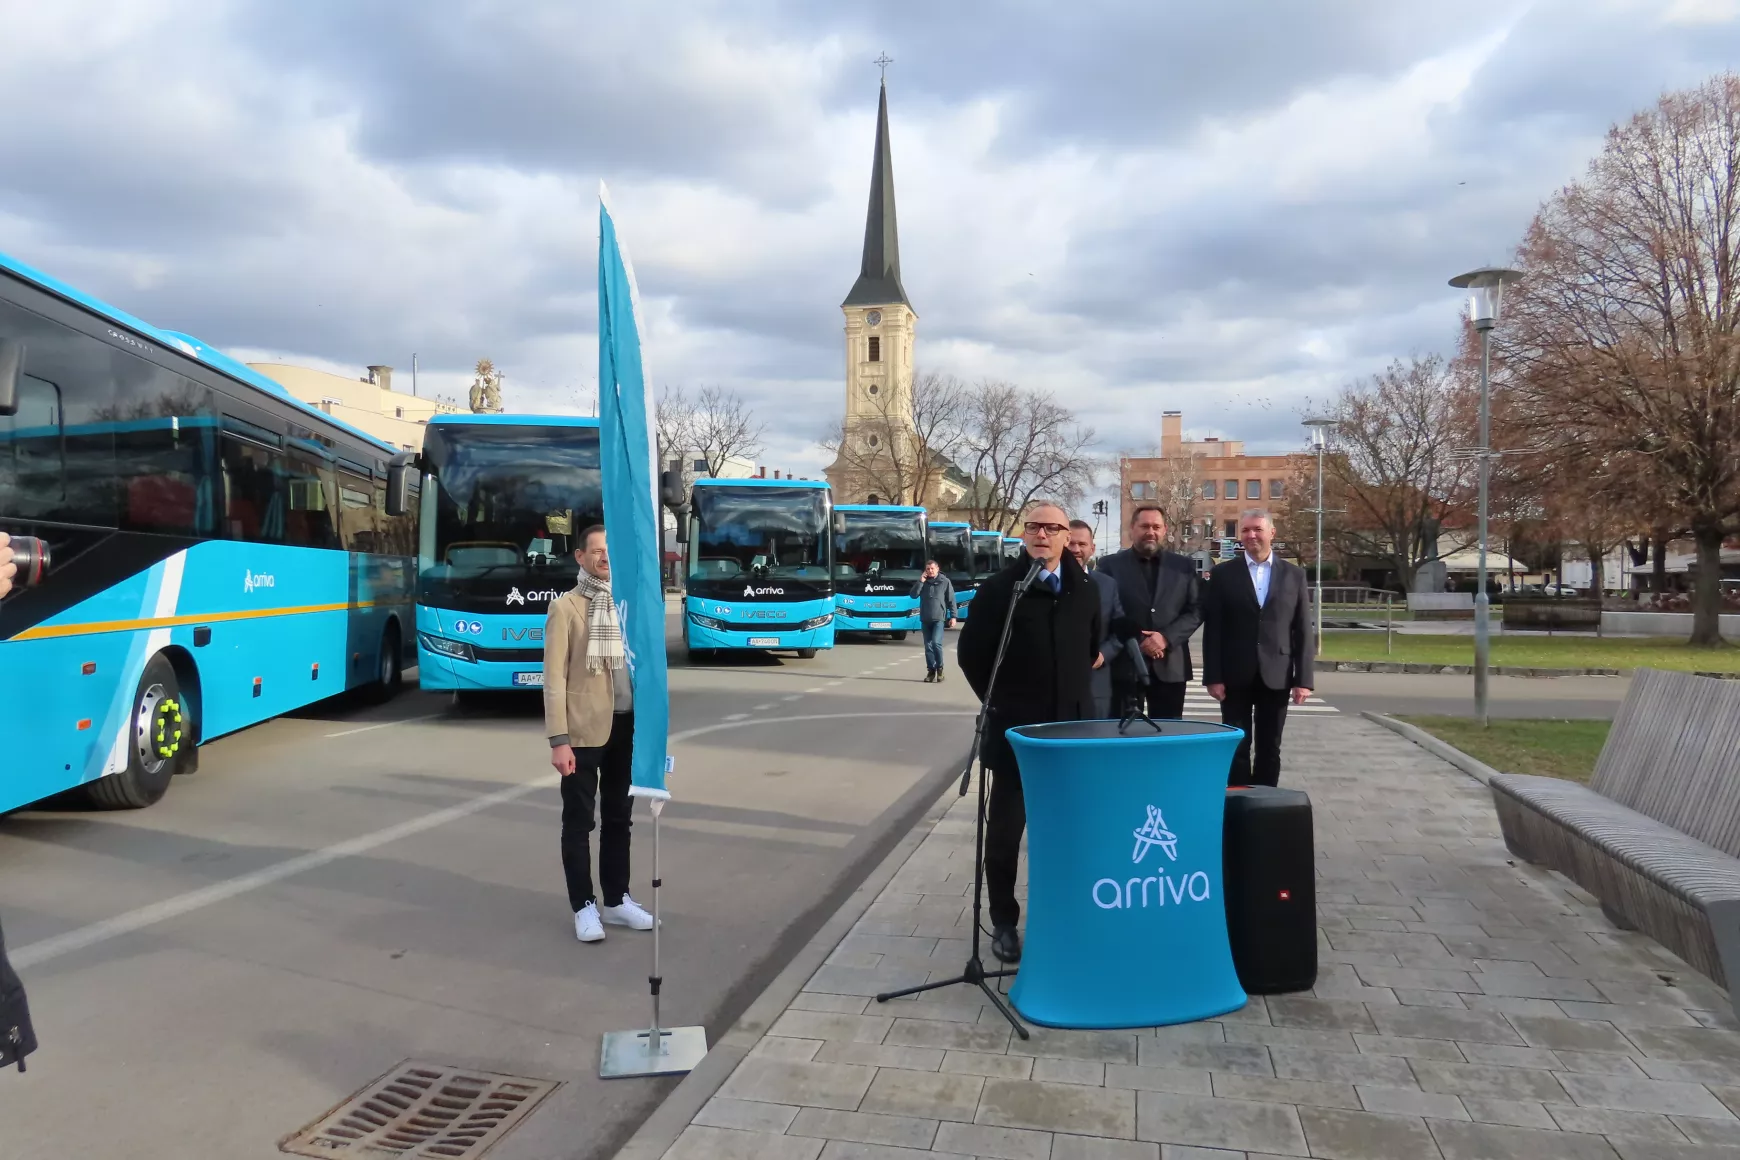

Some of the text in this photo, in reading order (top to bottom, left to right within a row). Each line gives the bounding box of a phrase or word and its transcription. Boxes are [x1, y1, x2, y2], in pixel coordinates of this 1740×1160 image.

[254, 571, 275, 588] arriva
[526, 588, 568, 601] arriv
[756, 586, 784, 595] arriva
[740, 610, 787, 619] IVECO
[501, 627, 544, 641] IVE
[1092, 867, 1210, 909] arriva
